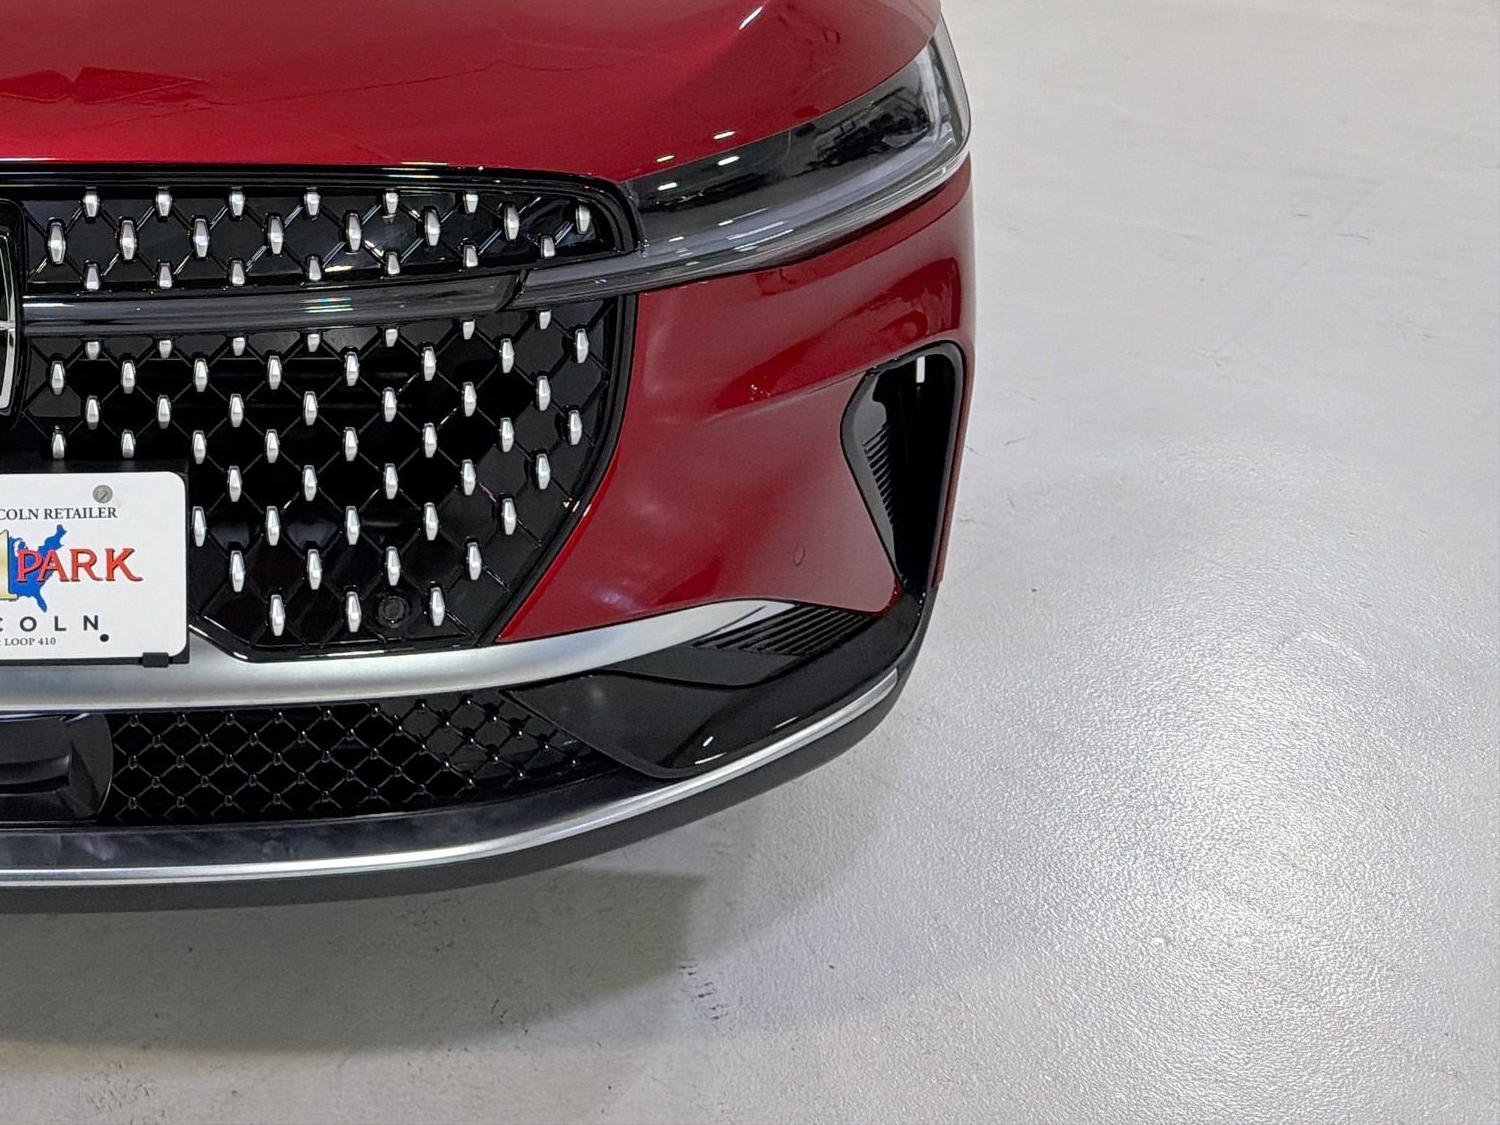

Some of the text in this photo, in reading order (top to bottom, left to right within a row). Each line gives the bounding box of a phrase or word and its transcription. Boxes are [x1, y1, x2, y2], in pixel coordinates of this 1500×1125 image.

[43, 507, 118, 520] RETAILER
[16, 547, 143, 583] PARK
[4, 637, 36, 647] LOOP
[38, 636, 57, 646] 410
